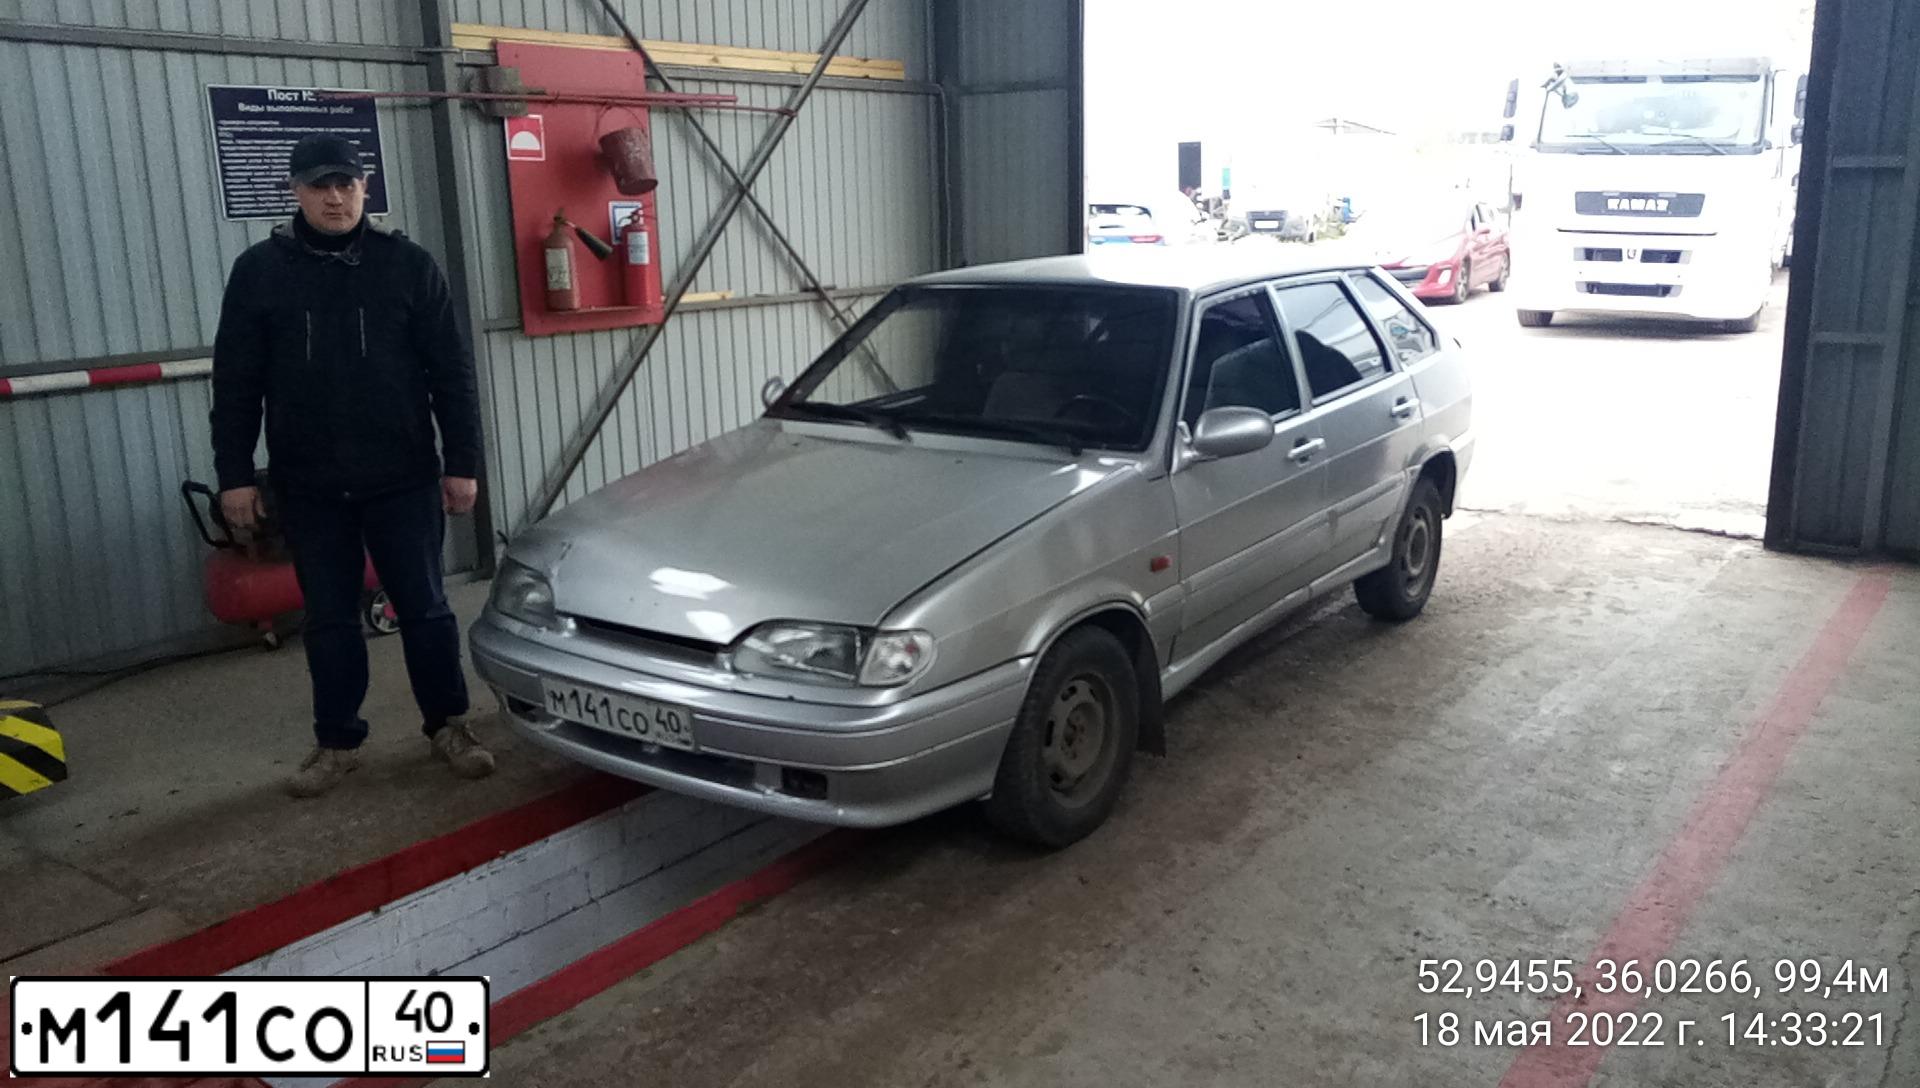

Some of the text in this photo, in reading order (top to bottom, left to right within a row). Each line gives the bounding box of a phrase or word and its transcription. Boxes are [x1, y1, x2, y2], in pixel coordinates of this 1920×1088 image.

[267, 88, 300, 102] Пост
[238, 102, 265, 113] Виды
[329, 105, 354, 115] работ
[655, 707, 681, 734] 40
